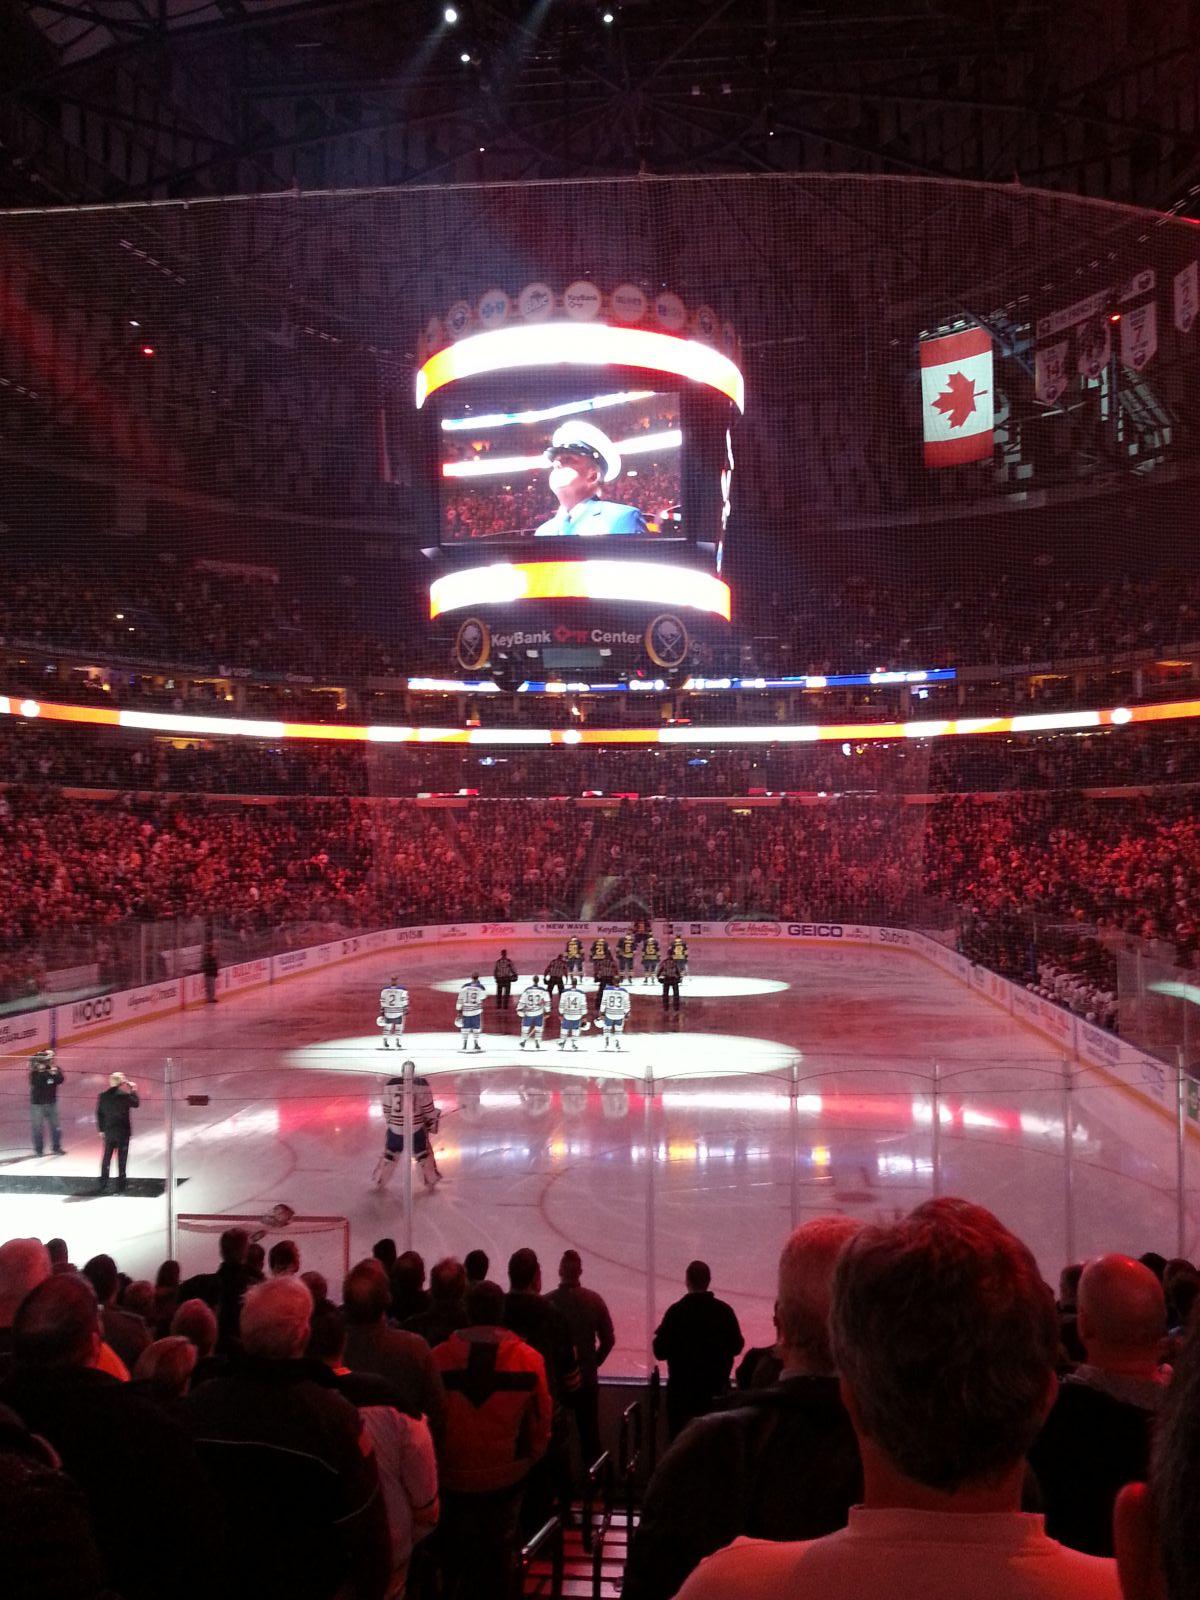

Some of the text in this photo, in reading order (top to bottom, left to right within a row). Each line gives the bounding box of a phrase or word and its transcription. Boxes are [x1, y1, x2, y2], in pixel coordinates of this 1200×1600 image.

[491, 629, 642, 648] KeyBank Center
[788, 924, 843, 938] GEICO
[389, 994, 396, 1006] 2
[567, 997, 577, 1009] 14
